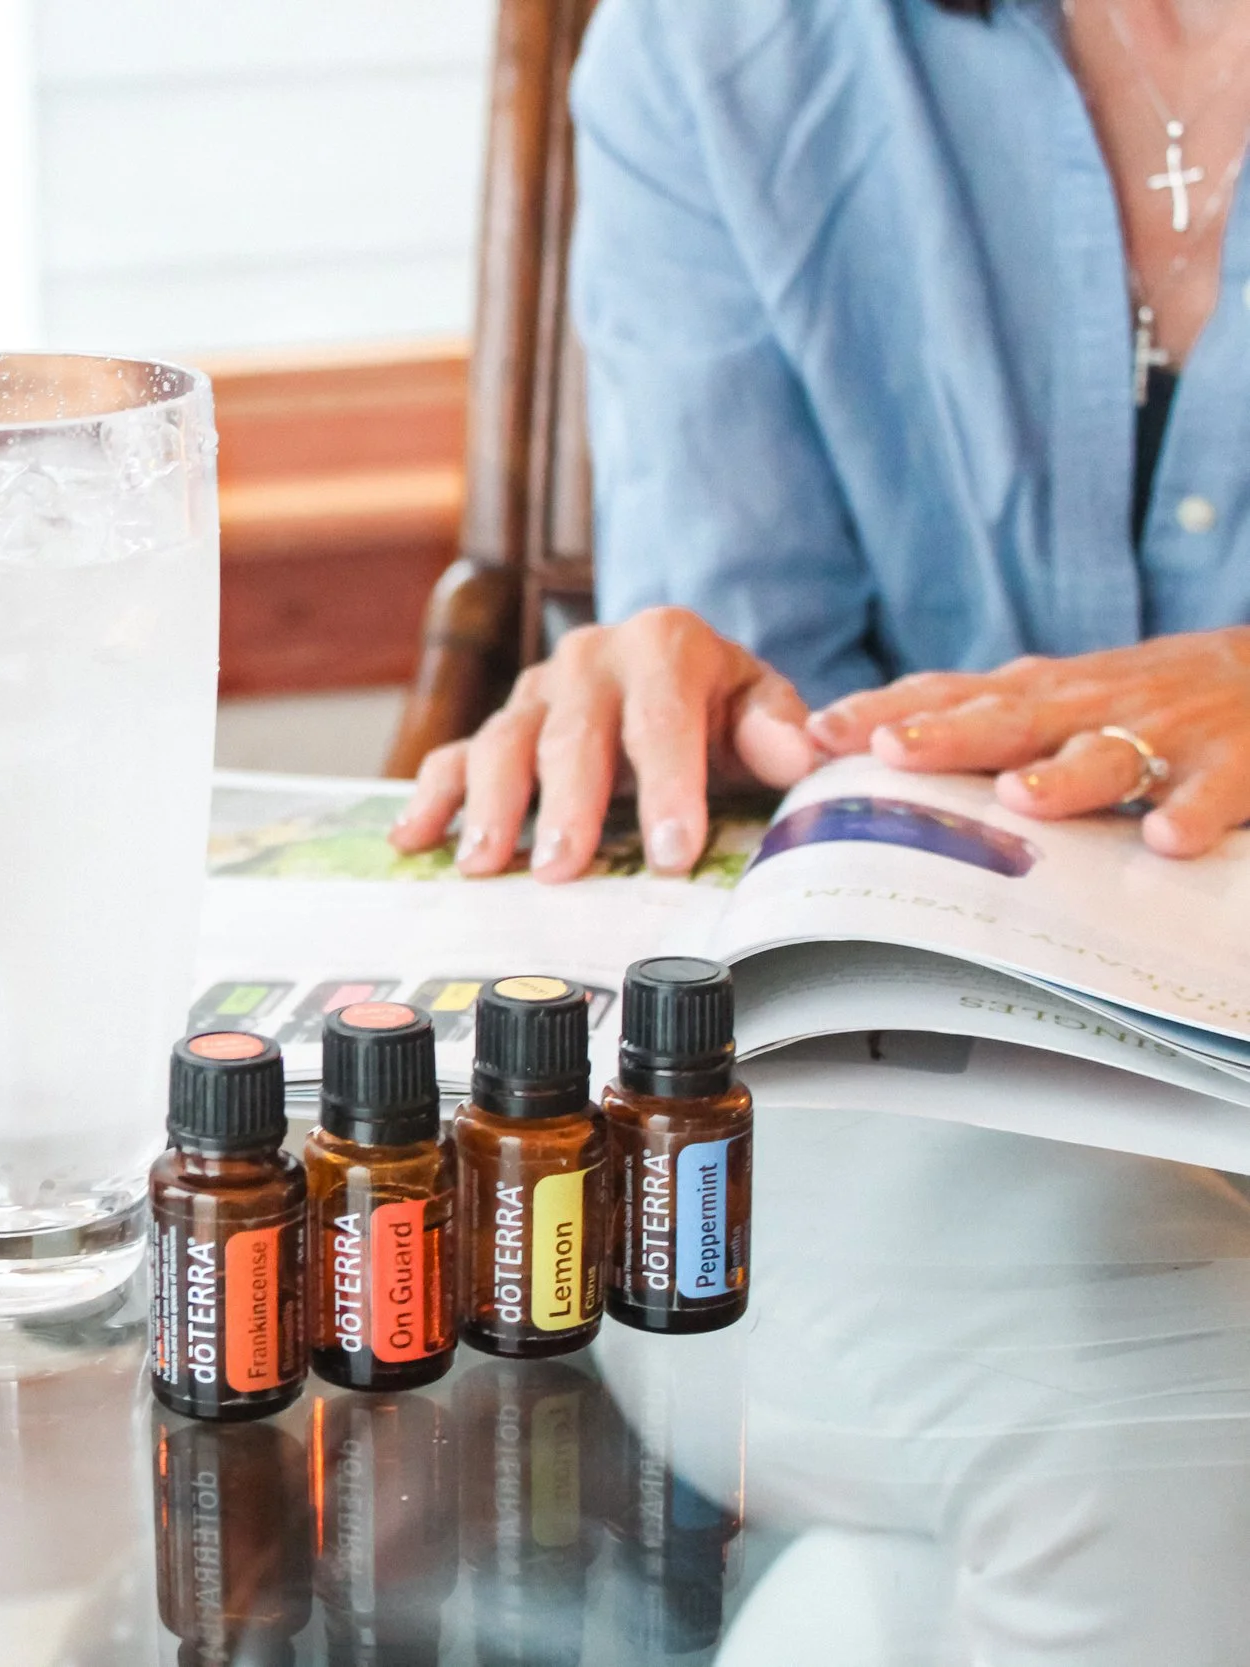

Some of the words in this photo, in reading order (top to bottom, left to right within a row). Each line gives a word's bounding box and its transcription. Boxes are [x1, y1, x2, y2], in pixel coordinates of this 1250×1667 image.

[389, 1220, 412, 1304] Guard
[549, 1221, 573, 1318] Lemon
[695, 1163, 720, 1289] Peppermint
[247, 1240, 268, 1379] Frankincense
[390, 1311, 412, 1349] On
[585, 1265, 596, 1310] Citrus
